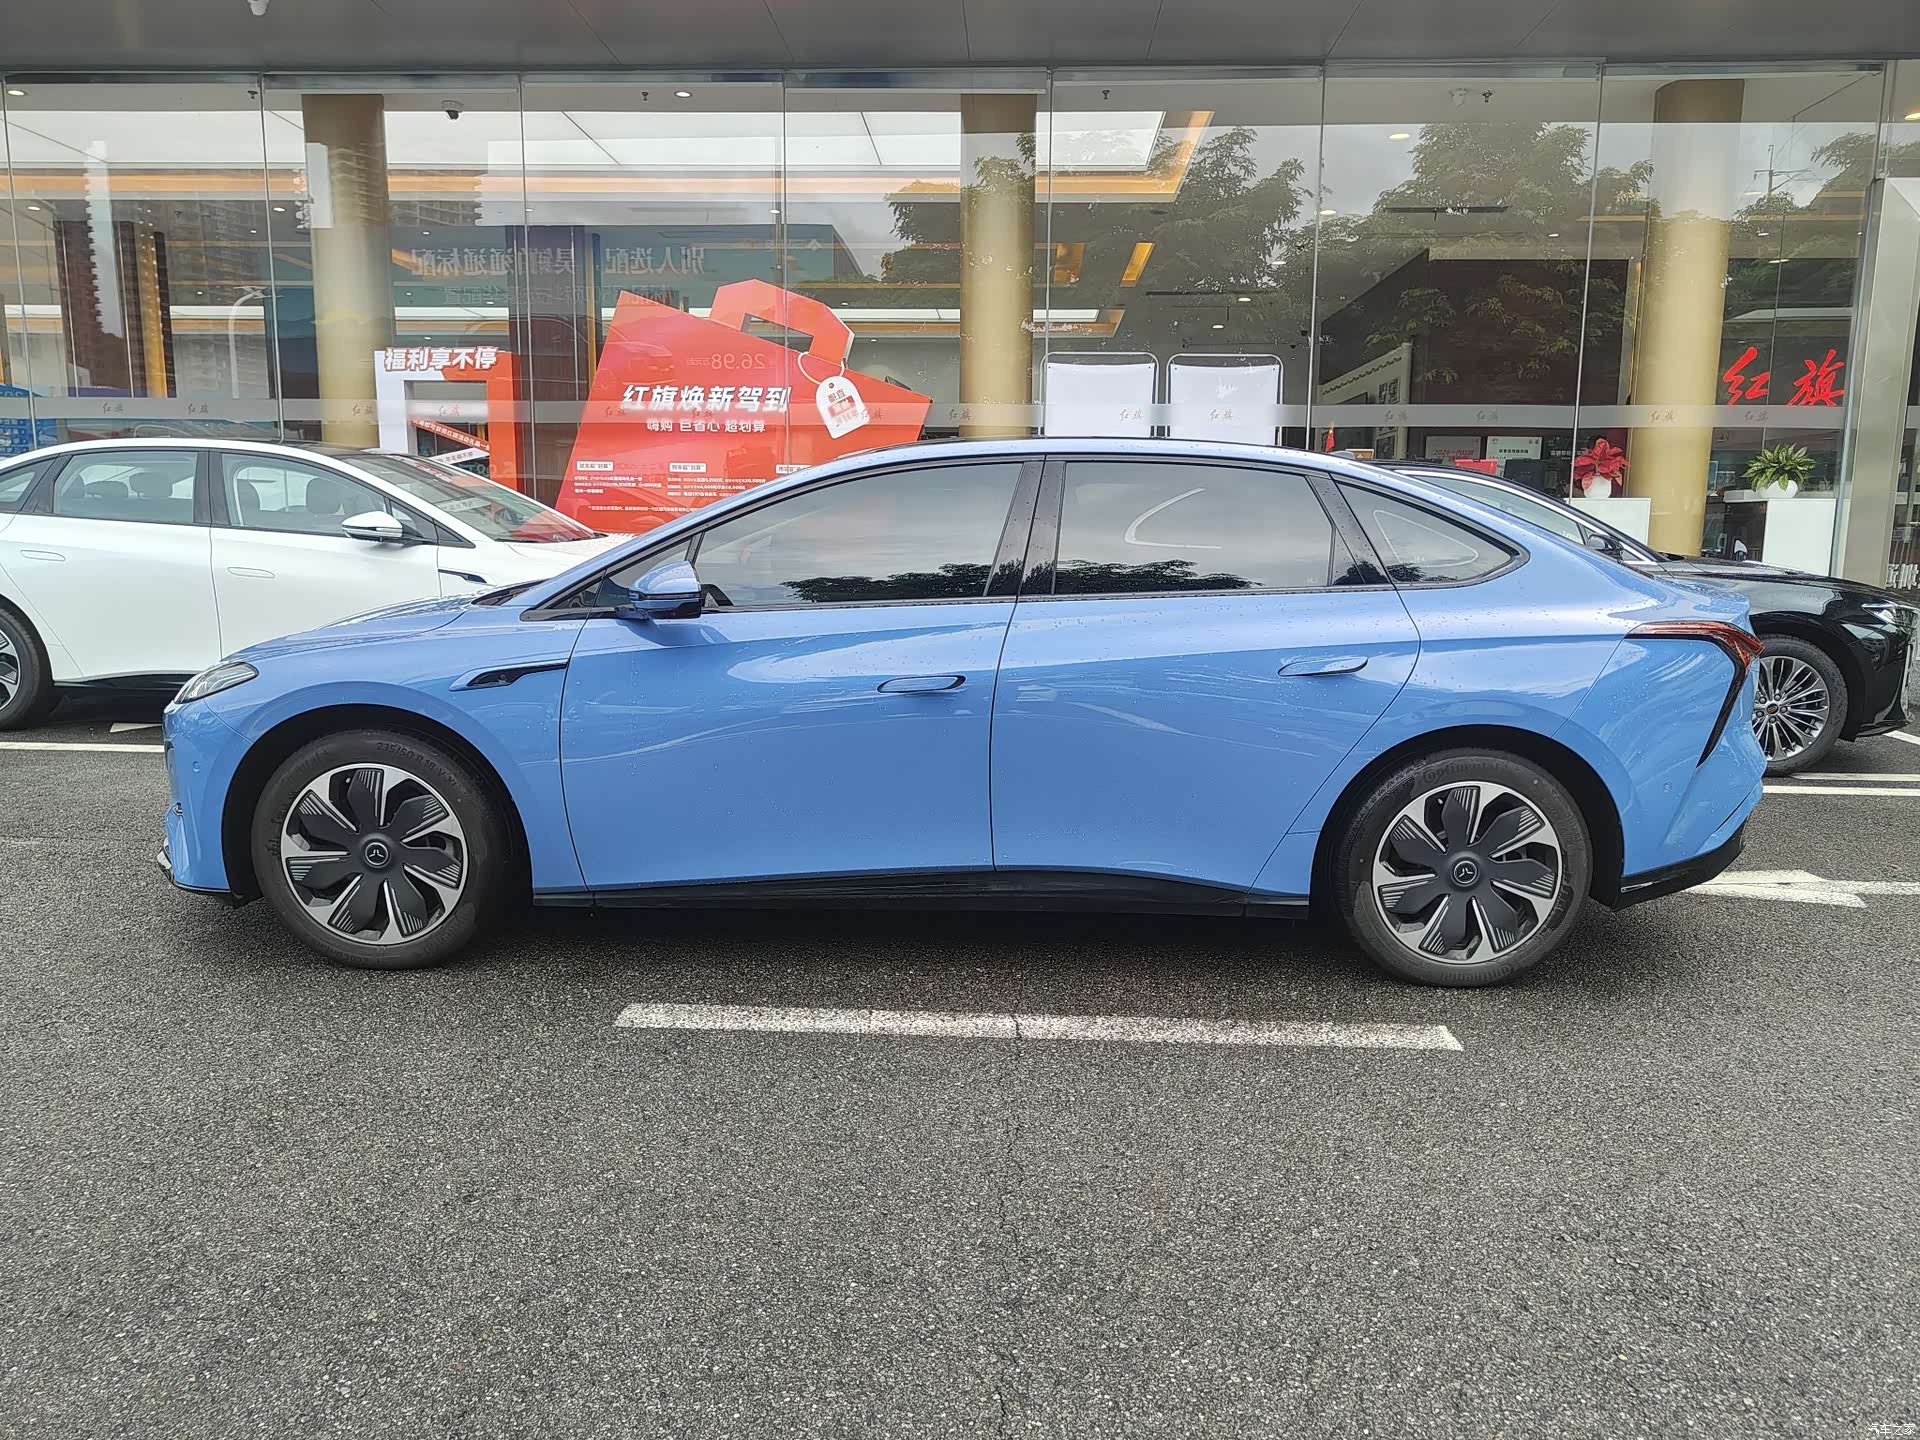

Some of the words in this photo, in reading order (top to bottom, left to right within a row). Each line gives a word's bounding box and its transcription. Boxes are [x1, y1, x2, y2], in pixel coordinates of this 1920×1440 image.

[384, 347, 498, 371] 福利享不停
[1722, 346, 1846, 407] 红旗
[621, 385, 793, 413] 红旗焕新驾到
[102, 402, 125, 414] 红旗
[186, 403, 209, 414] 红旗
[948, 408, 972, 420] 红旗
[1120, 408, 1144, 421] 红旗
[1209, 408, 1233, 421] 红旗
[647, 418, 673, 432] 嗨购
[680, 418, 721, 432] 巨省心
[724, 418, 766, 432] 超划算
